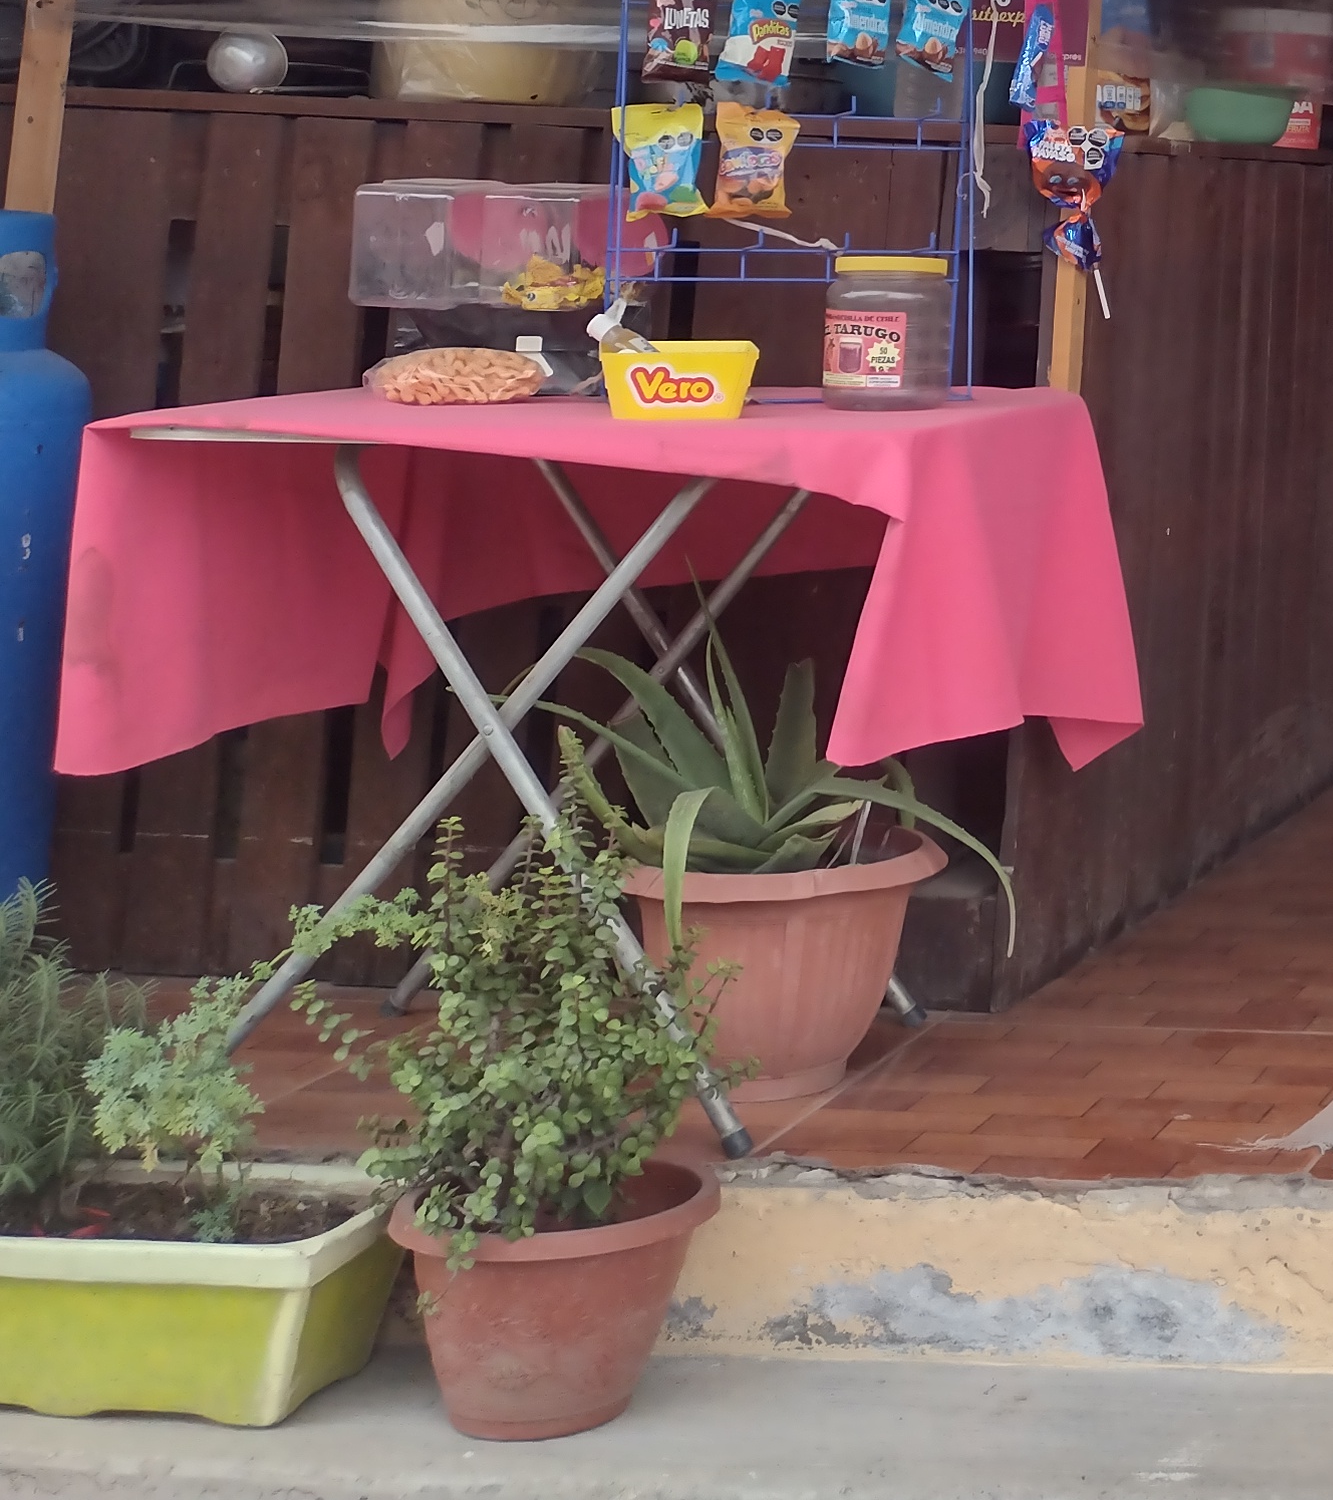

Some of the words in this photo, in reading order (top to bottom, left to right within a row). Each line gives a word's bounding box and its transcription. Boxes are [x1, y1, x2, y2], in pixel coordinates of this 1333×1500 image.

[664, 7, 710, 30] LUNETAS
[752, 20, 790, 42] Panditas
[833, 323, 901, 343] TARUGO
[870, 356, 896, 365] PIEZAS
[631, 367, 714, 403] Vero
